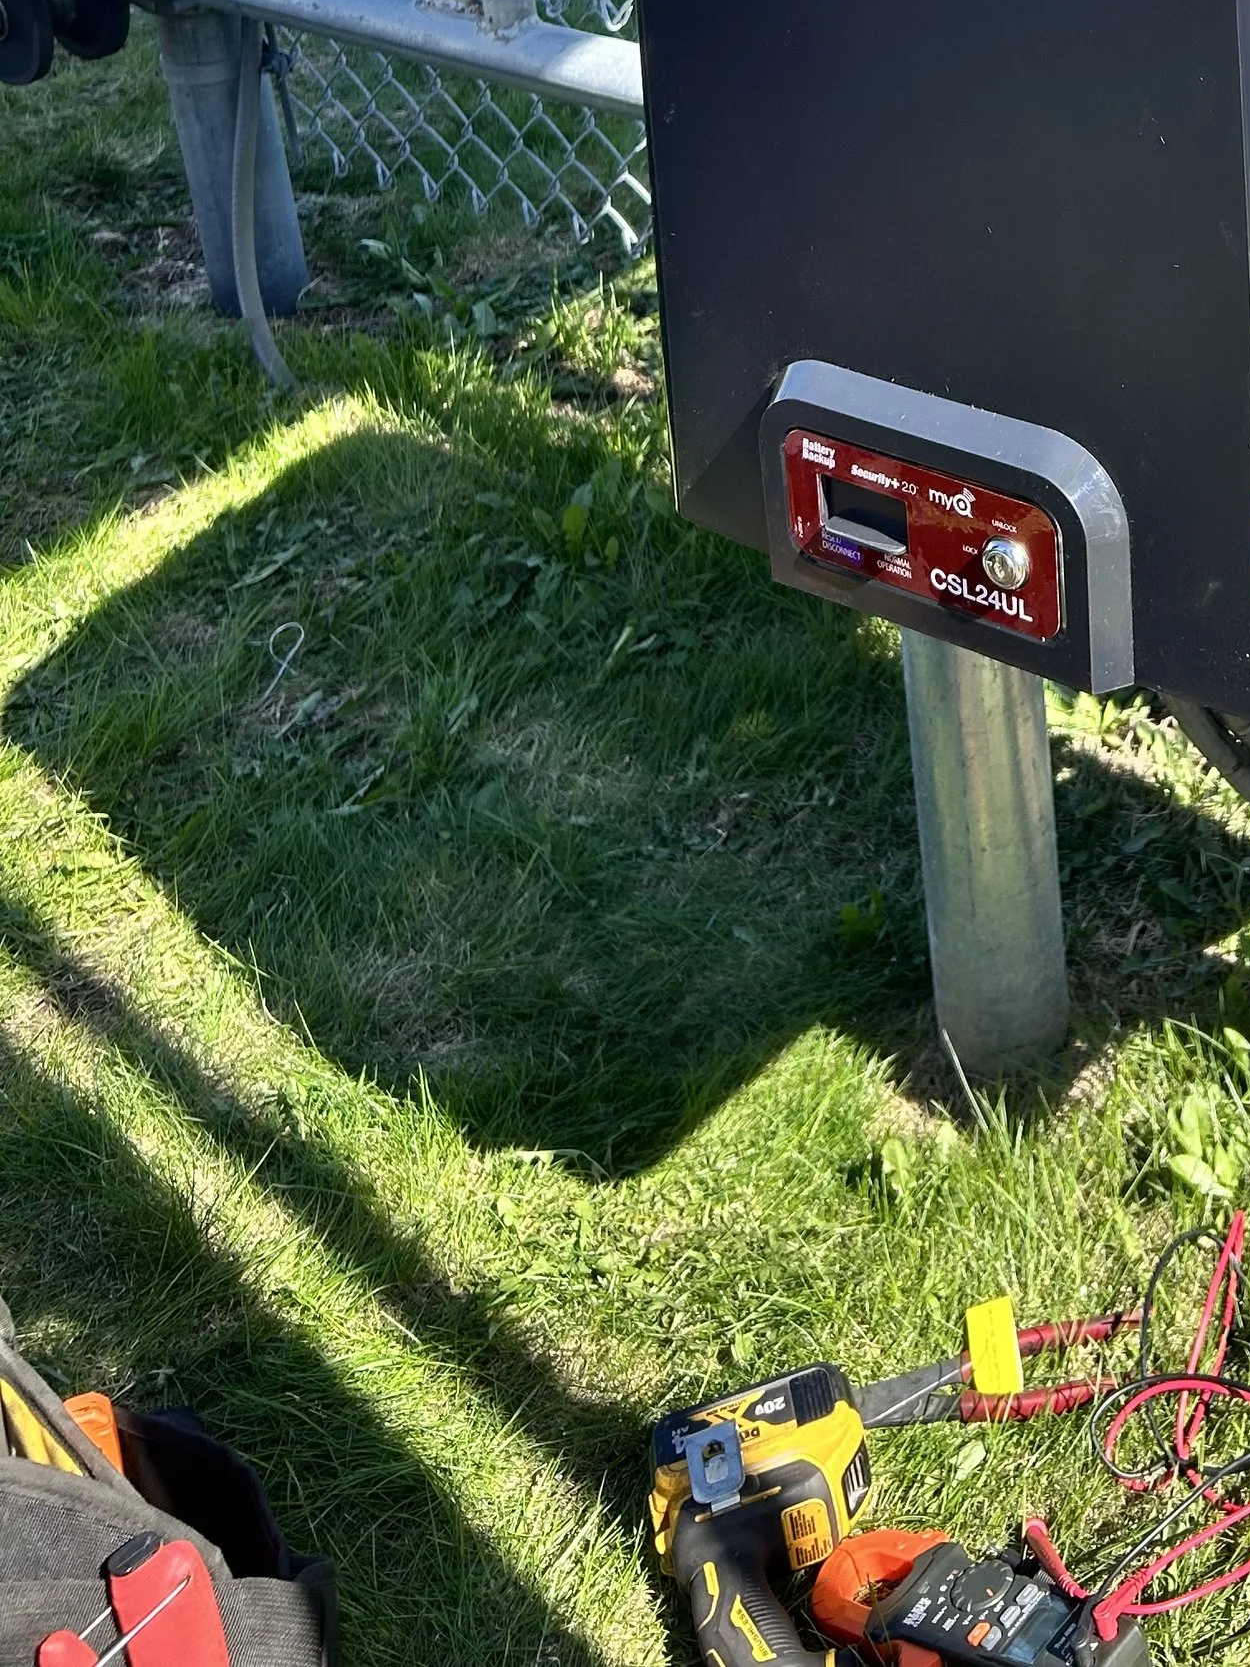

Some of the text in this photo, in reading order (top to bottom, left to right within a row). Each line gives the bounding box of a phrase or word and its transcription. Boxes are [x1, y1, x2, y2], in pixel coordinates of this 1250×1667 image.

[802, 437, 836, 457] Battery
[802, 448, 836, 470] Backup
[928, 488, 974, 519] myQ
[991, 519, 1018, 533] UNLOCK
[822, 540, 861, 560] DISCONNECT
[962, 544, 979, 554] LOCK
[876, 560, 912, 579] OPERATION
[884, 554, 911, 570] NORMAL
[929, 568, 1034, 622] CSL24UL
[735, 1608, 769, 1657] BRUSHLESS
